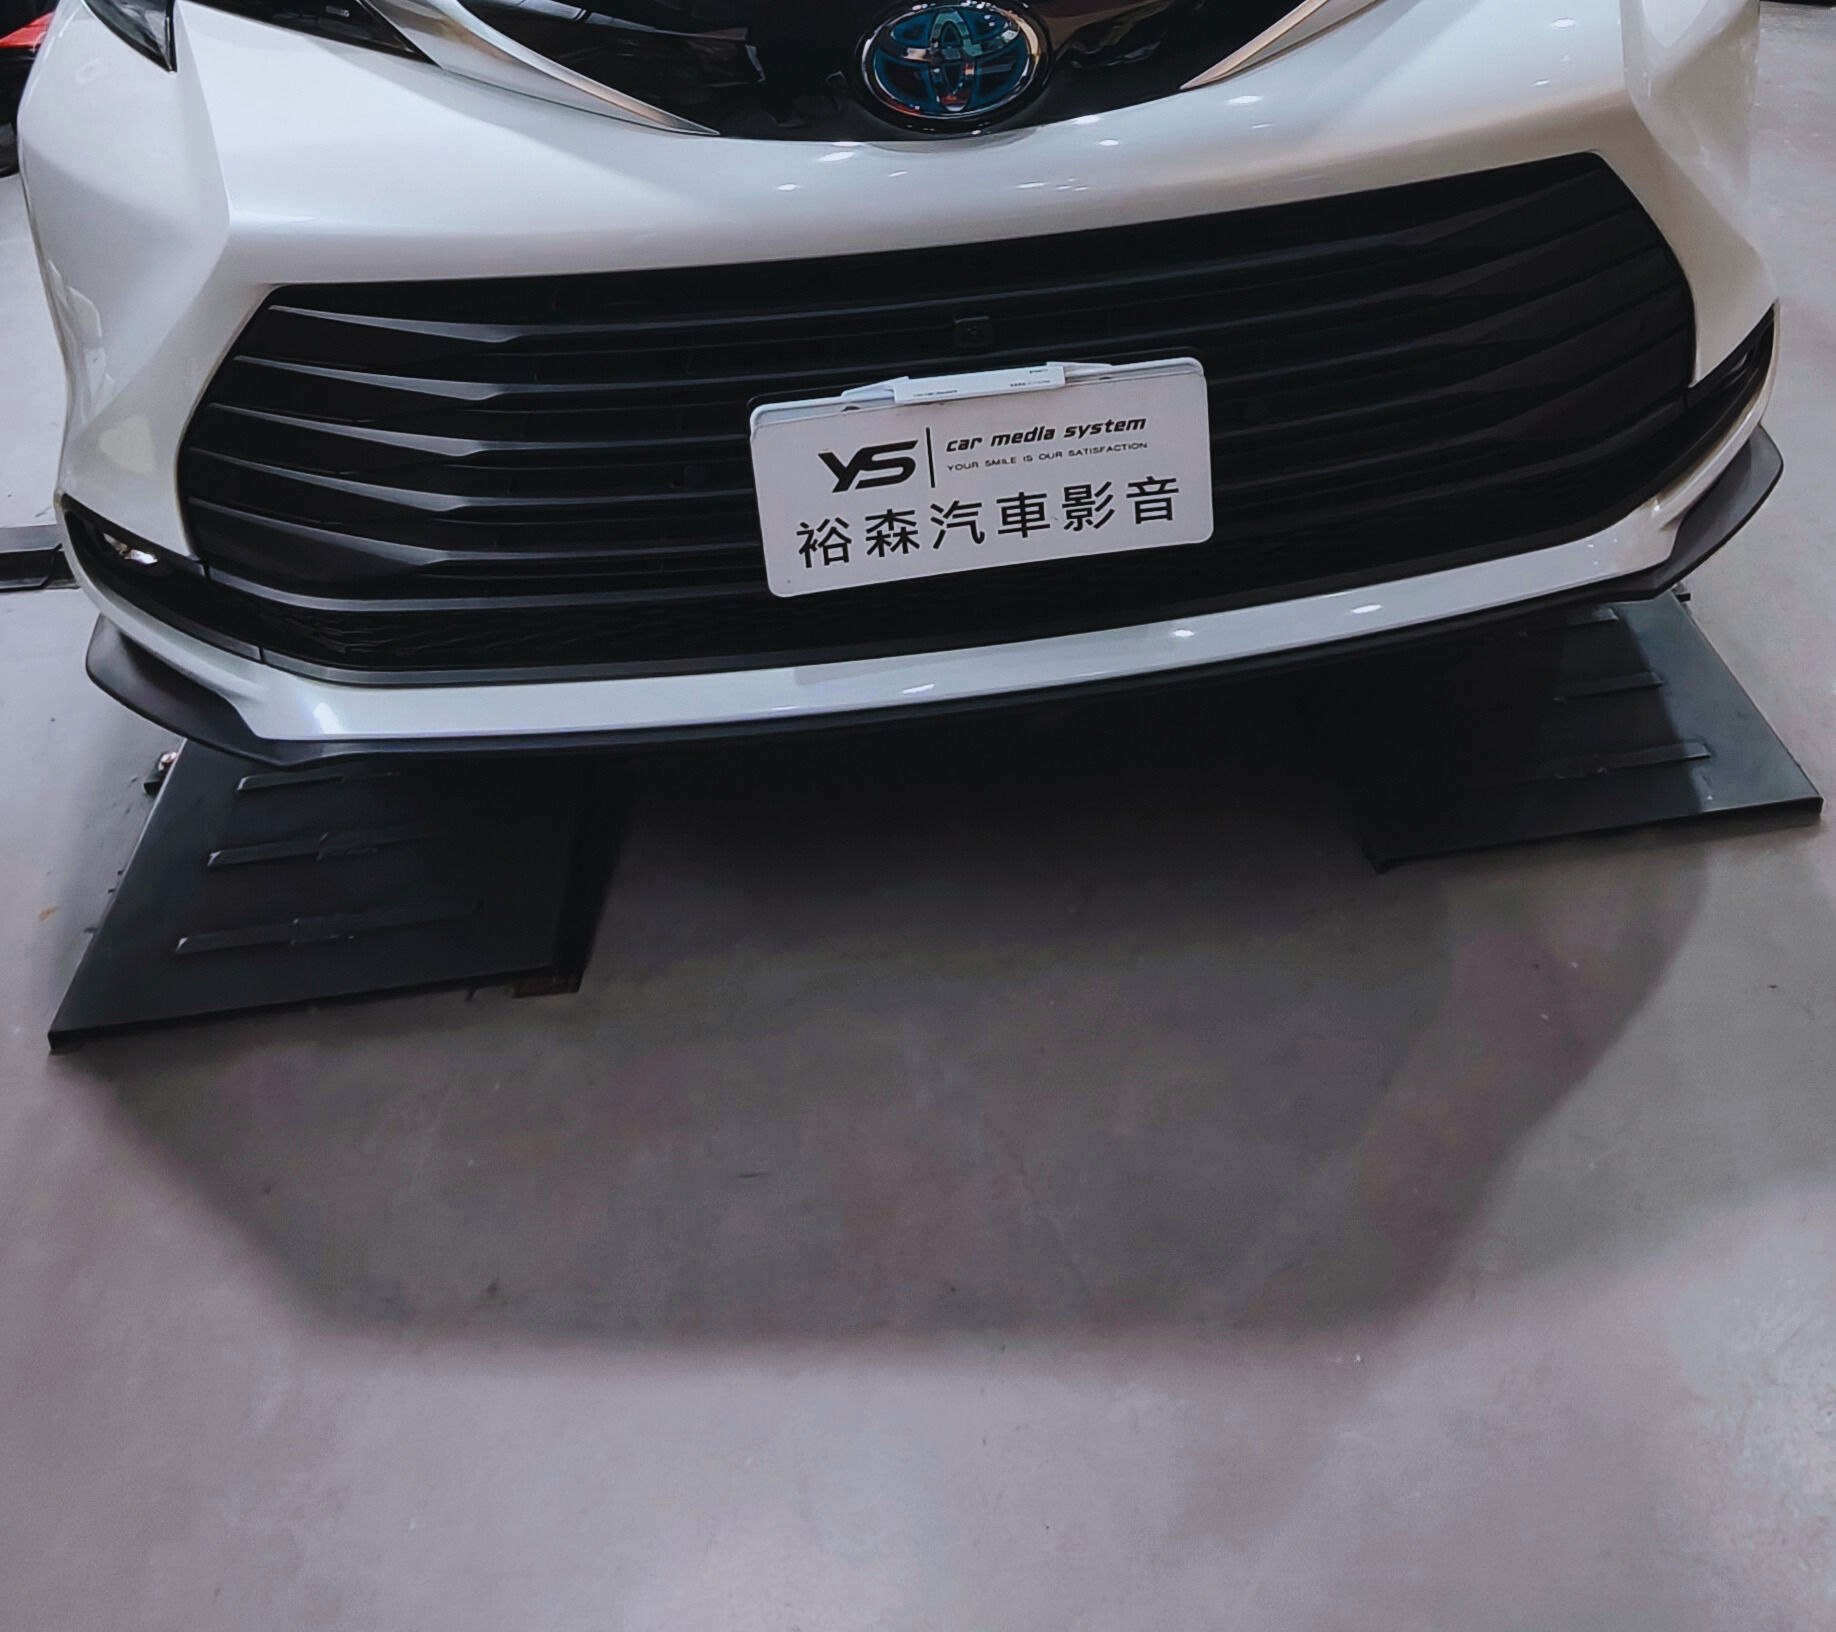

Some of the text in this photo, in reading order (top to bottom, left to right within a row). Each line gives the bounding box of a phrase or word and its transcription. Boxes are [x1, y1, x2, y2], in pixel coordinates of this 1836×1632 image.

[946, 418, 1147, 452] car media system
[947, 442, 1149, 471] YOUR SMILE IS OUR SATISFACTION
[817, 439, 919, 493] YS
[796, 475, 1180, 568] 裕森汽車影音
